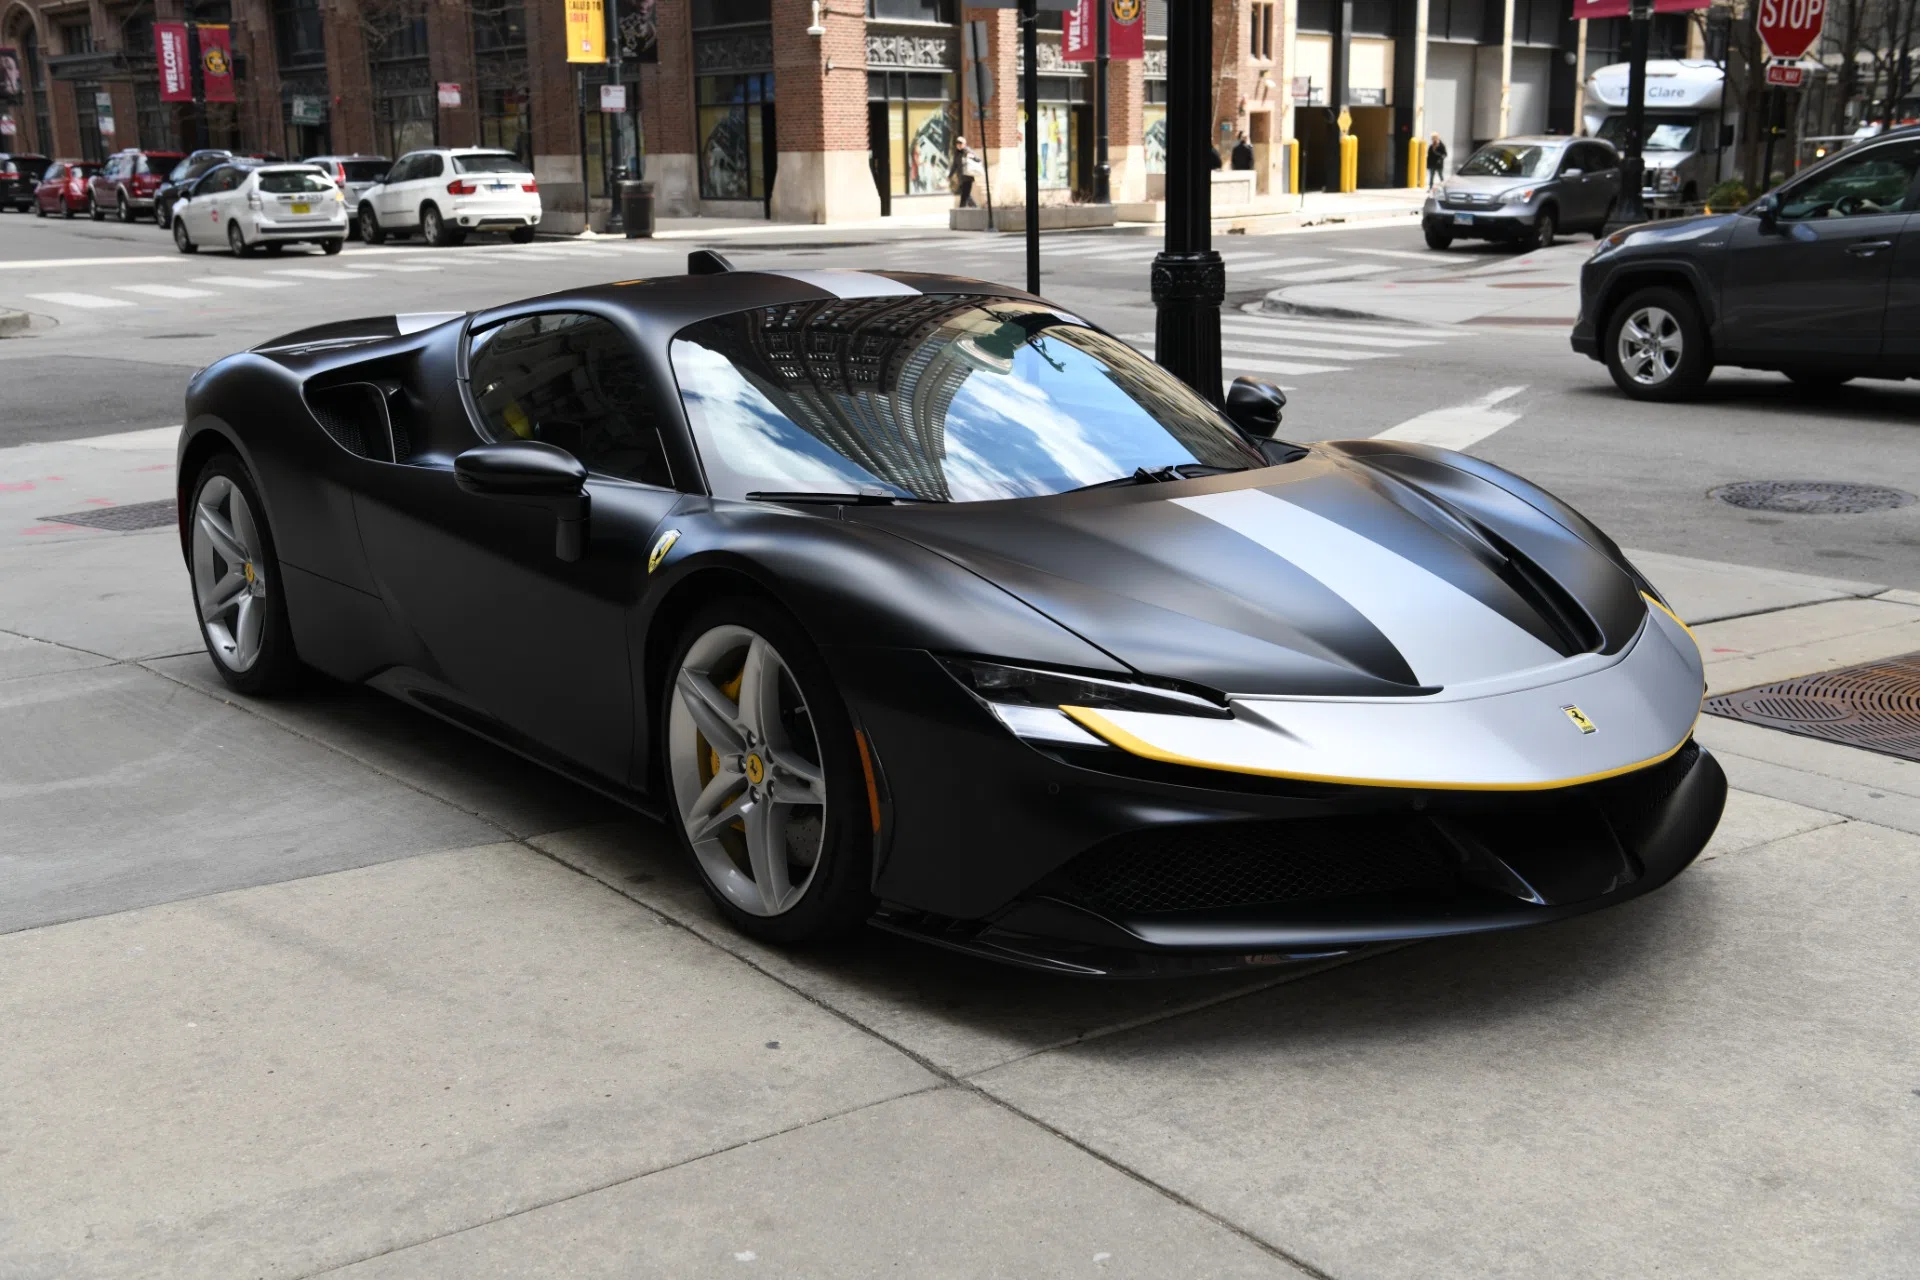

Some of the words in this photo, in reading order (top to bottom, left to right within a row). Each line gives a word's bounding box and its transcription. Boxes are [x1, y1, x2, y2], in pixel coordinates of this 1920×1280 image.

[1068, 0, 1081, 52] WELC
[1762, 0, 1823, 29] STOP
[161, 31, 179, 94] WELCOME
[1771, 69, 1783, 81] ALL
[1785, 70, 1799, 82] WAY
[1648, 87, 1685, 98] Clare
